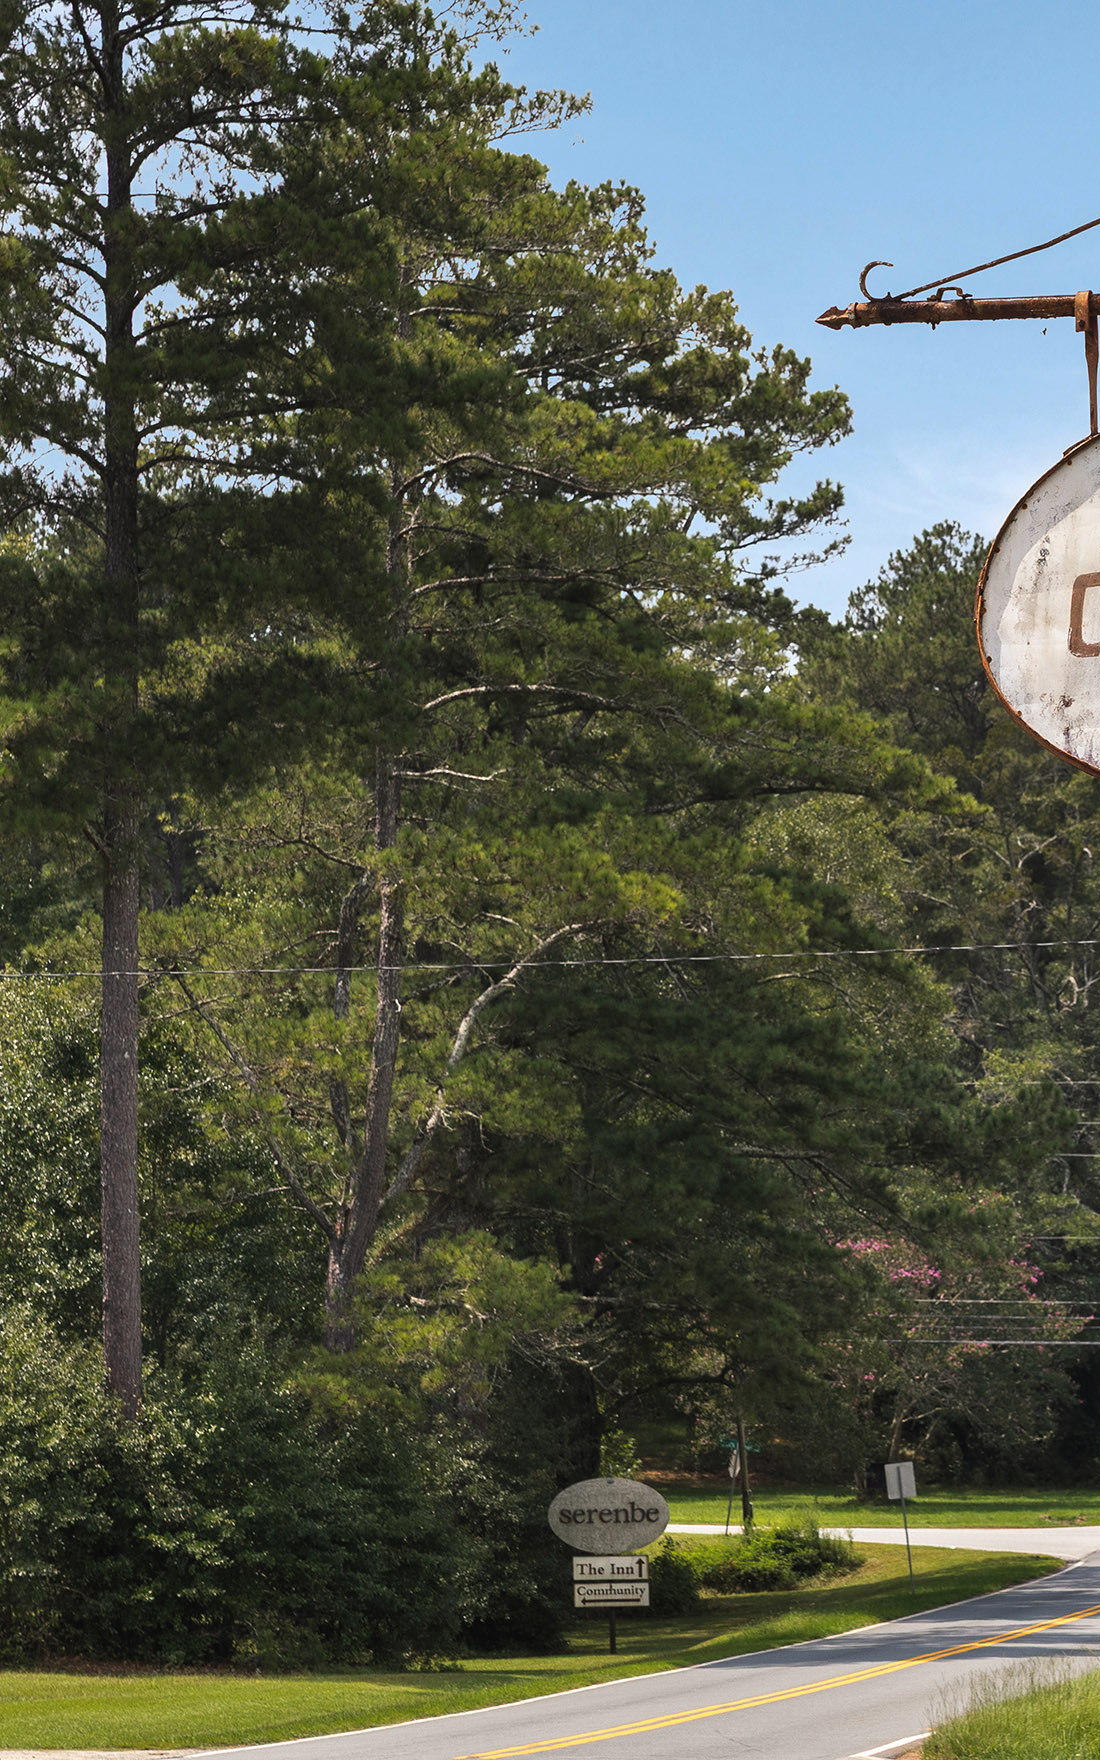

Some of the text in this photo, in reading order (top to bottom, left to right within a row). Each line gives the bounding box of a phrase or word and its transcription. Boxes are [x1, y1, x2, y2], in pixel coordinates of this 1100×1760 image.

[558, 1501, 660, 1525] serenbe
[576, 1563, 634, 1576] The Inn
[576, 1585, 646, 1599] Community
